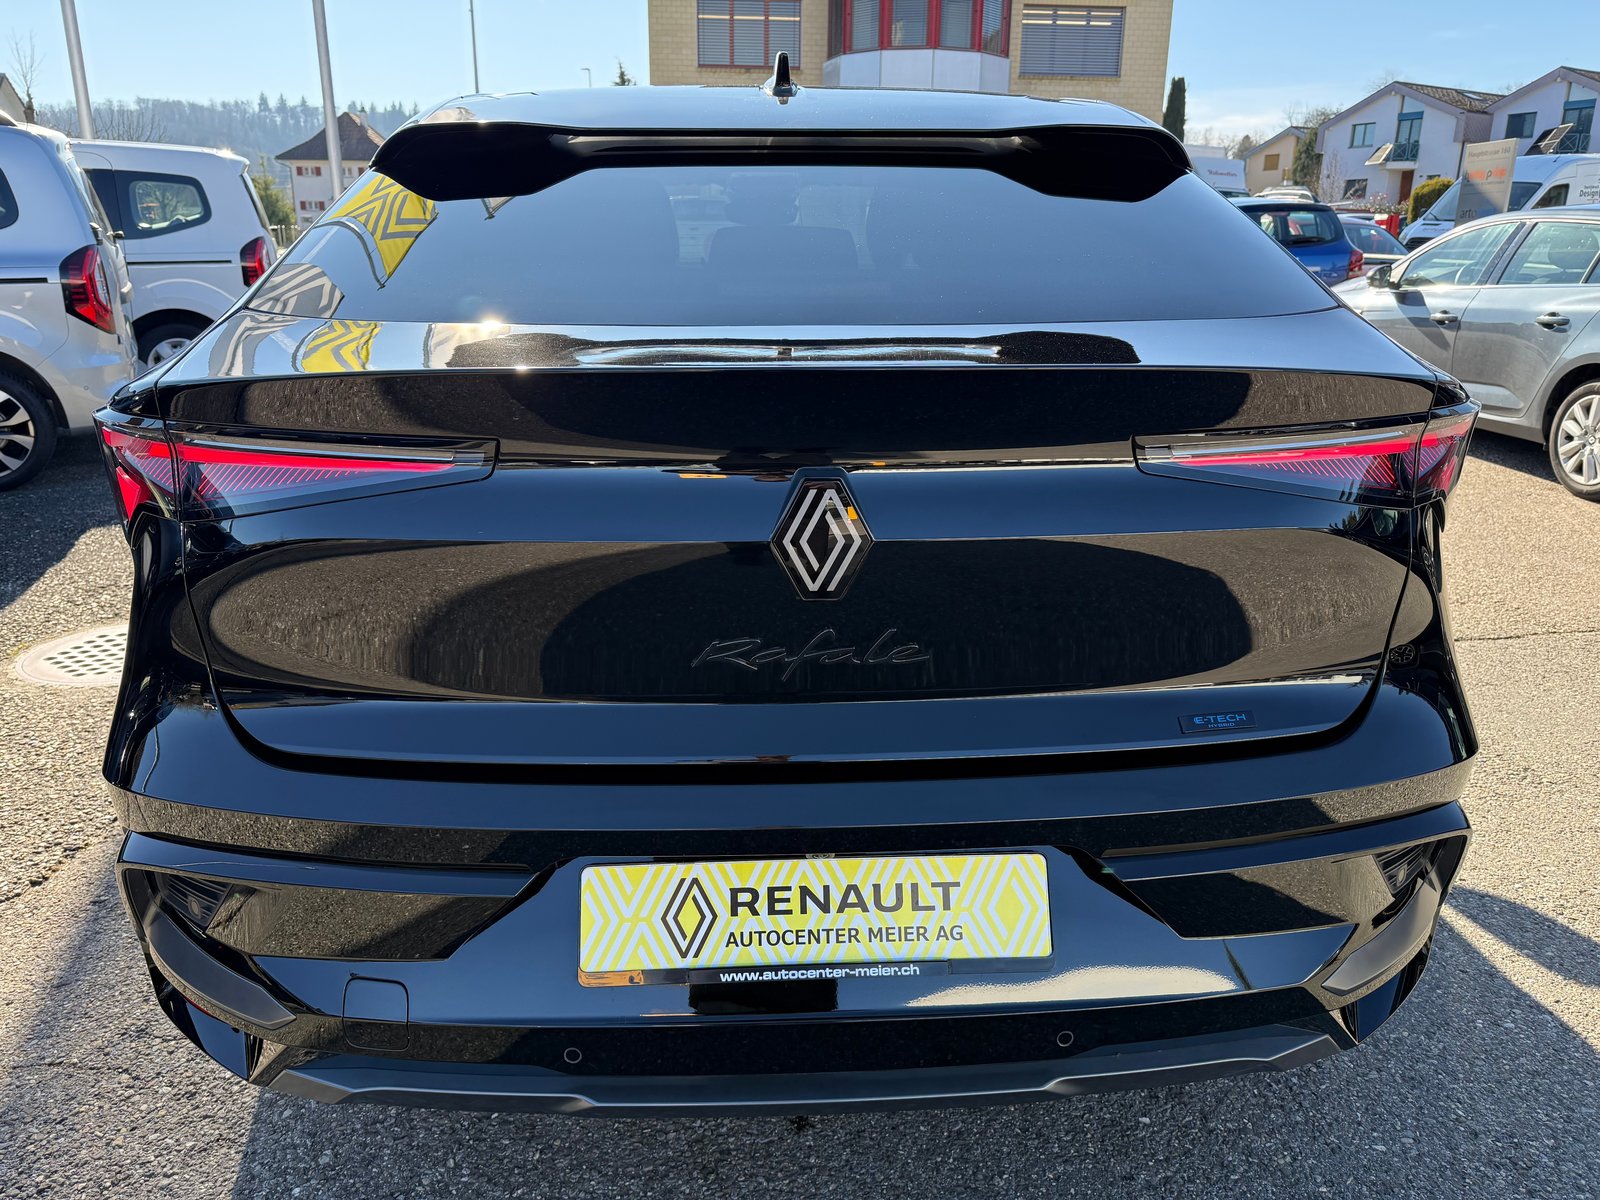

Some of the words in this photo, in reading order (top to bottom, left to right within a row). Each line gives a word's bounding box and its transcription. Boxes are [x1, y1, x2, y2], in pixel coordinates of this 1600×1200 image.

[690, 627, 930, 681] Rafale
[1193, 713, 1247, 724] E-TECH
[729, 882, 960, 917] RENAULT
[725, 929, 861, 948] AUTOCENTER
[868, 926, 930, 943] MEIER
[935, 925, 963, 941] AG
[719, 964, 920, 982] www.autocenter-meier.ch
